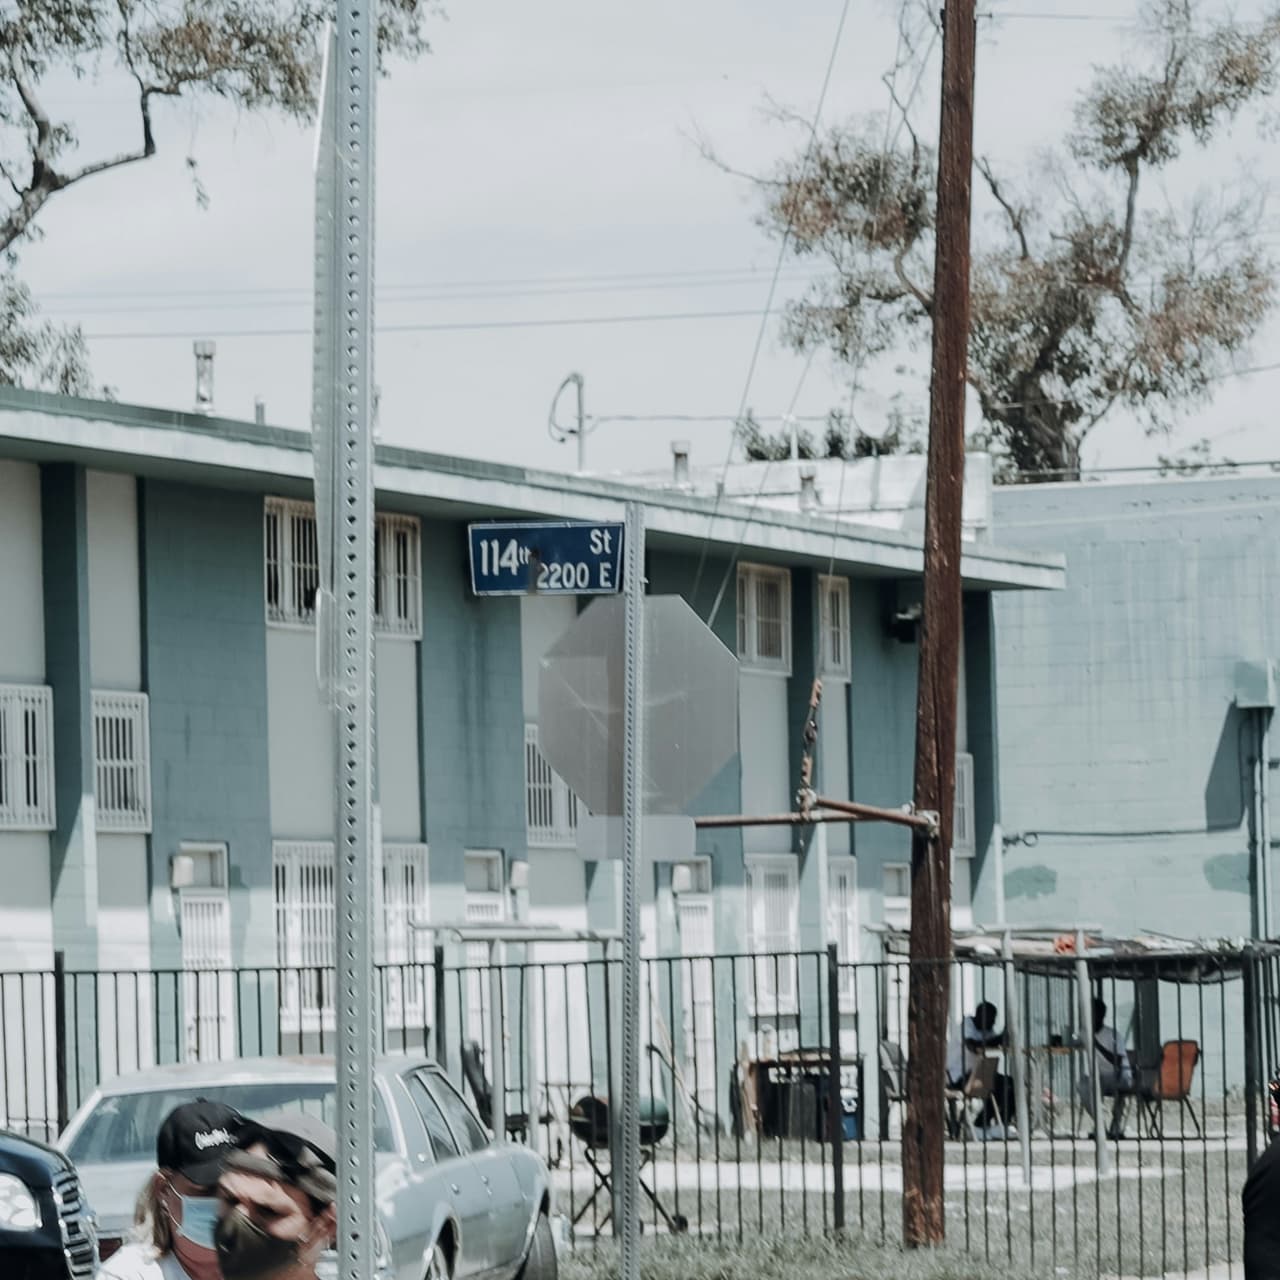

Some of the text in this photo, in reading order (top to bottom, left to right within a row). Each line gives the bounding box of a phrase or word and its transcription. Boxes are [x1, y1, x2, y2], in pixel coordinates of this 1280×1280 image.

[590, 529, 612, 554] St
[537, 562, 612, 588] 2200 E
